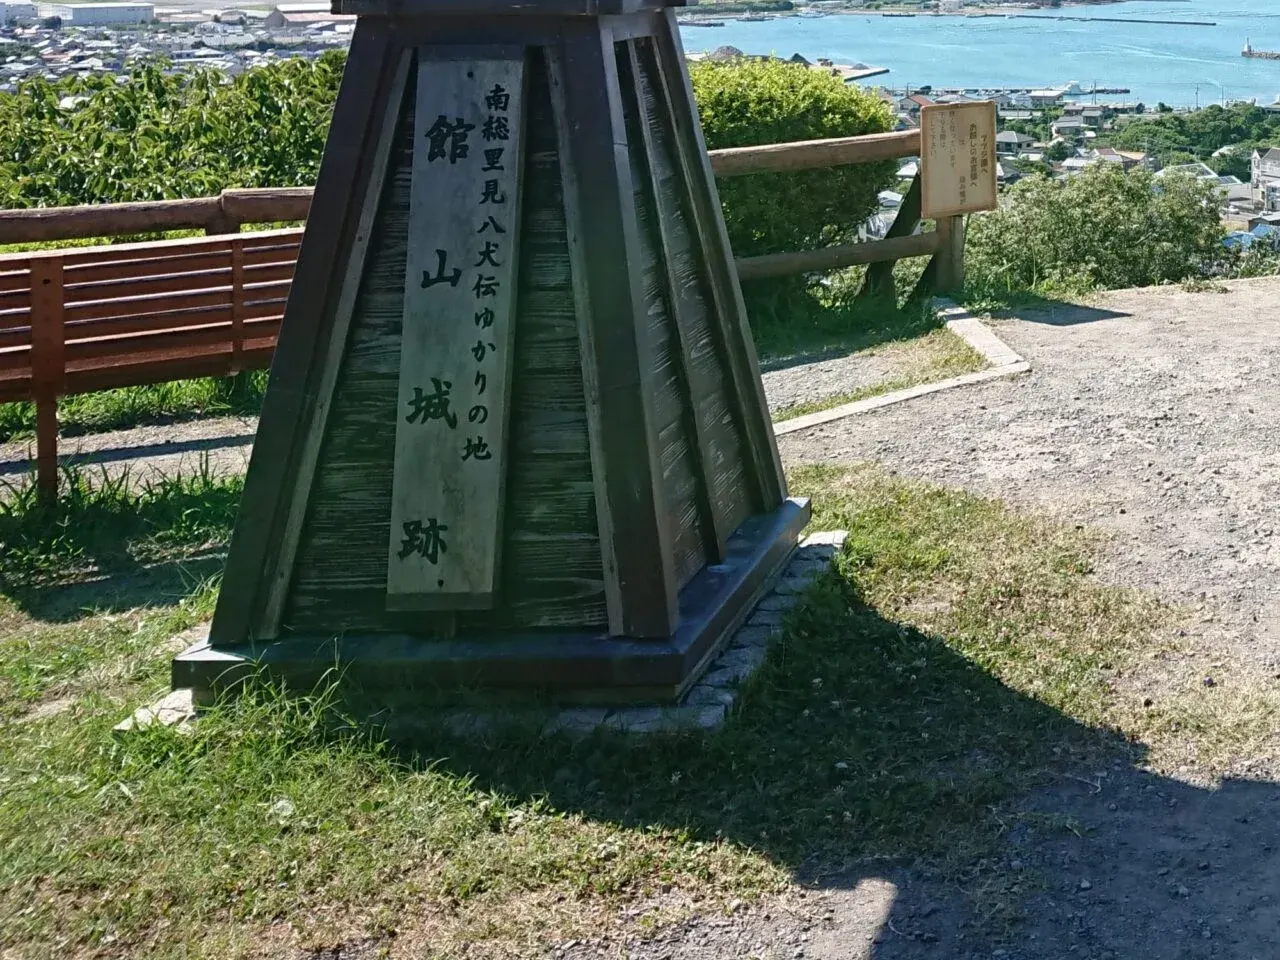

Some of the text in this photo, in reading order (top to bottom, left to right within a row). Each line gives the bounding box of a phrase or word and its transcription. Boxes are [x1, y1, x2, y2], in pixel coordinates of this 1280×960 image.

[397, 115, 475, 565] 館山城跡
[461, 83, 511, 461] 南総里見八犬伝ゆかりの地
